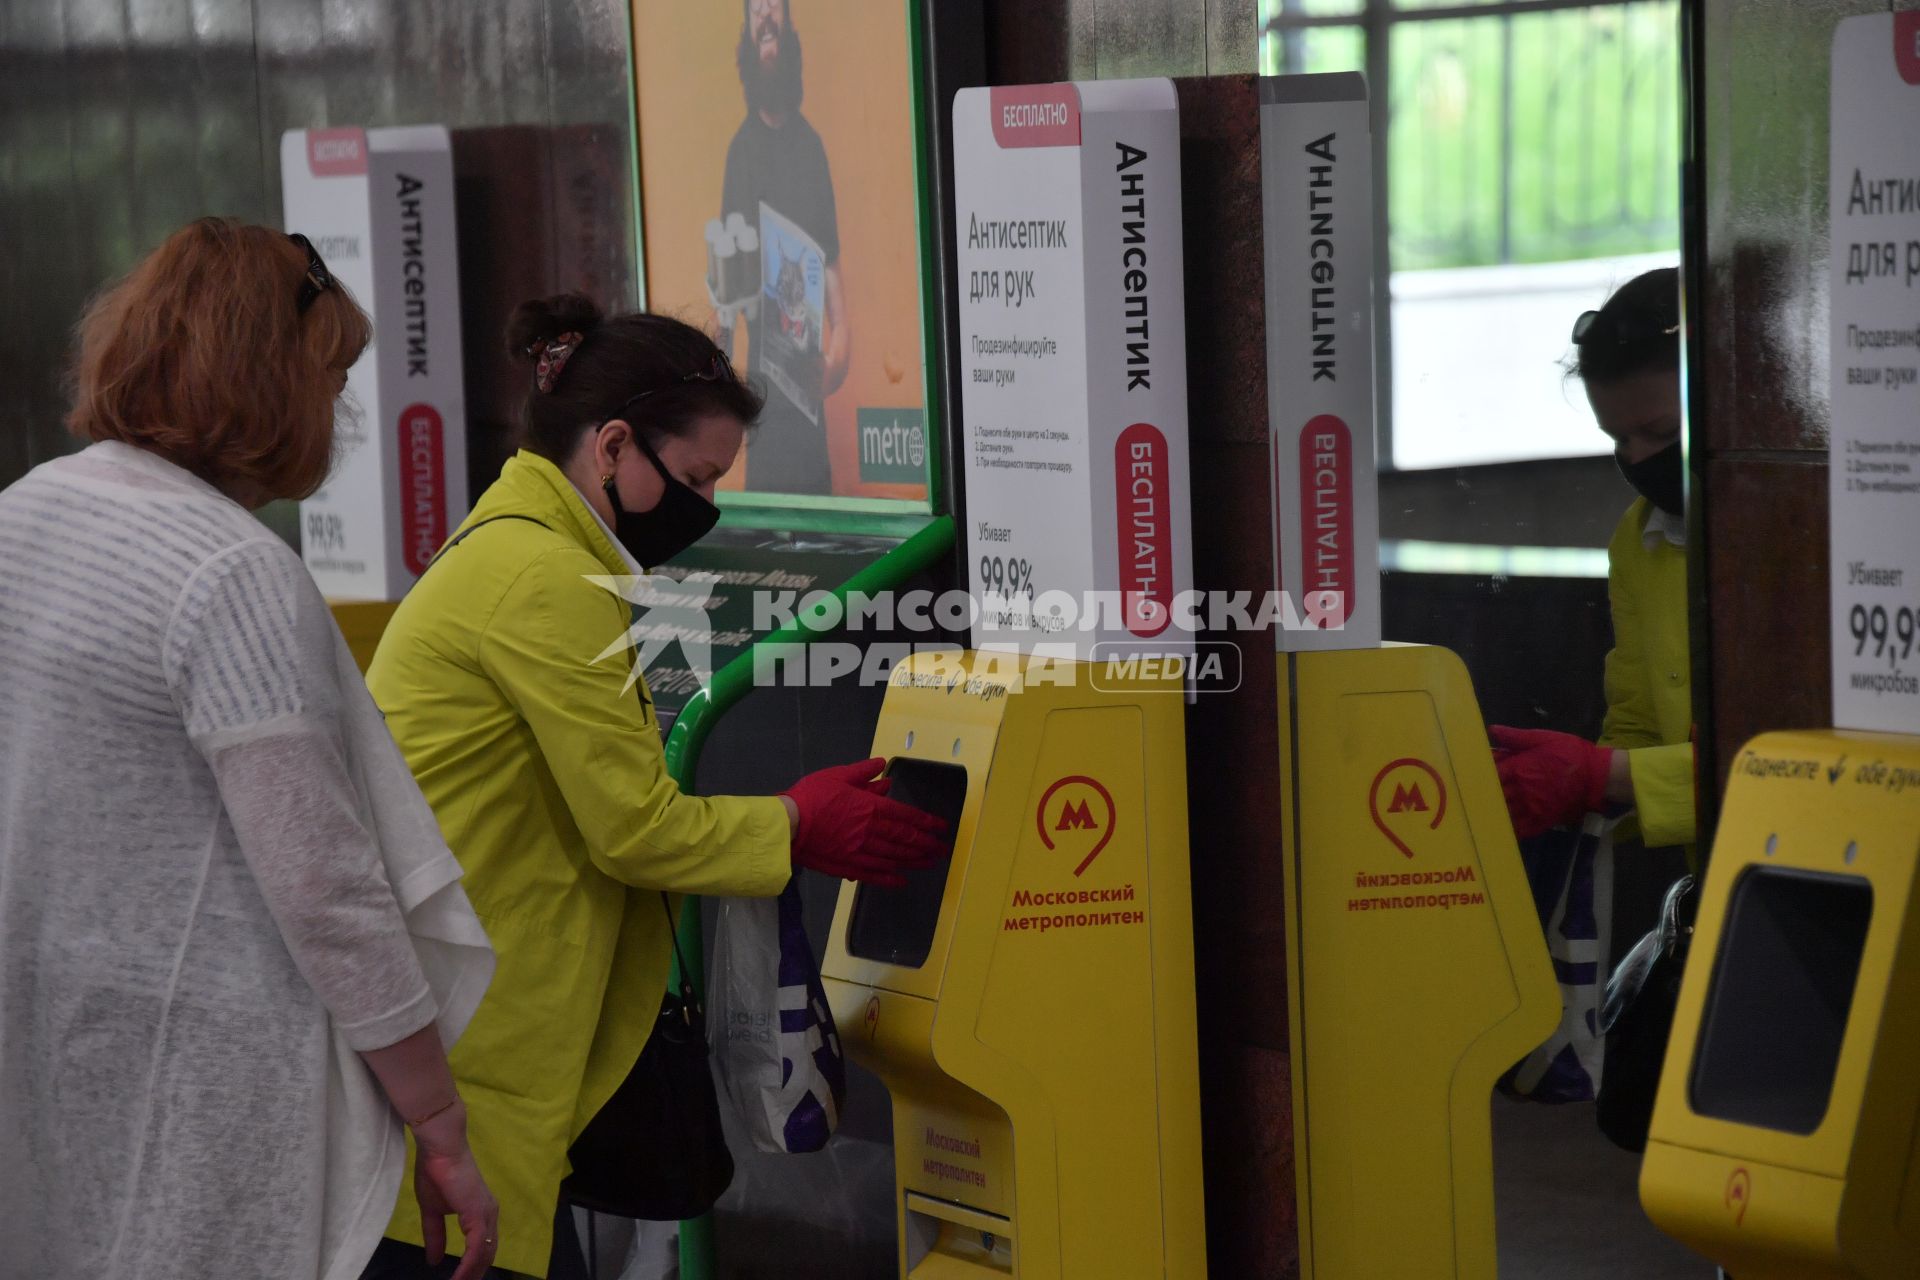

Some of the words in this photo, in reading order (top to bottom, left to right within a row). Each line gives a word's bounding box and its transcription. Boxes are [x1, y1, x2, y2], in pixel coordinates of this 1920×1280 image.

[1003, 102, 1068, 128] БЕСПЛАТНО
[968, 212, 1068, 250] Антисептик
[396, 173, 428, 378] Антисептик
[1115, 141, 1151, 392] Антисептик
[1846, 242, 1896, 285] для
[970, 269, 999, 304] для
[1005, 269, 1036, 308] рук
[972, 334, 1057, 358] Продезинфицируйте
[973, 367, 994, 384] ваши
[995, 368, 1015, 388] руки
[1847, 367, 1881, 386] ваши
[862, 419, 925, 468] metro
[978, 522, 1012, 543] Убивает
[1130, 441, 1159, 620] БЕСПЛАТНО
[980, 555, 1034, 606] 99,9%
[1847, 561, 1904, 587] Убивает
[982, 608, 1023, 628] микробов
[892, 666, 943, 691] Поднесите
[963, 673, 981, 696] обе
[981, 681, 1008, 702] руки
[1012, 884, 1135, 907] Московский
[1004, 911, 1144, 932] метрополитен
[926, 1127, 981, 1158] Московский
[923, 1158, 987, 1188] метрополитен
